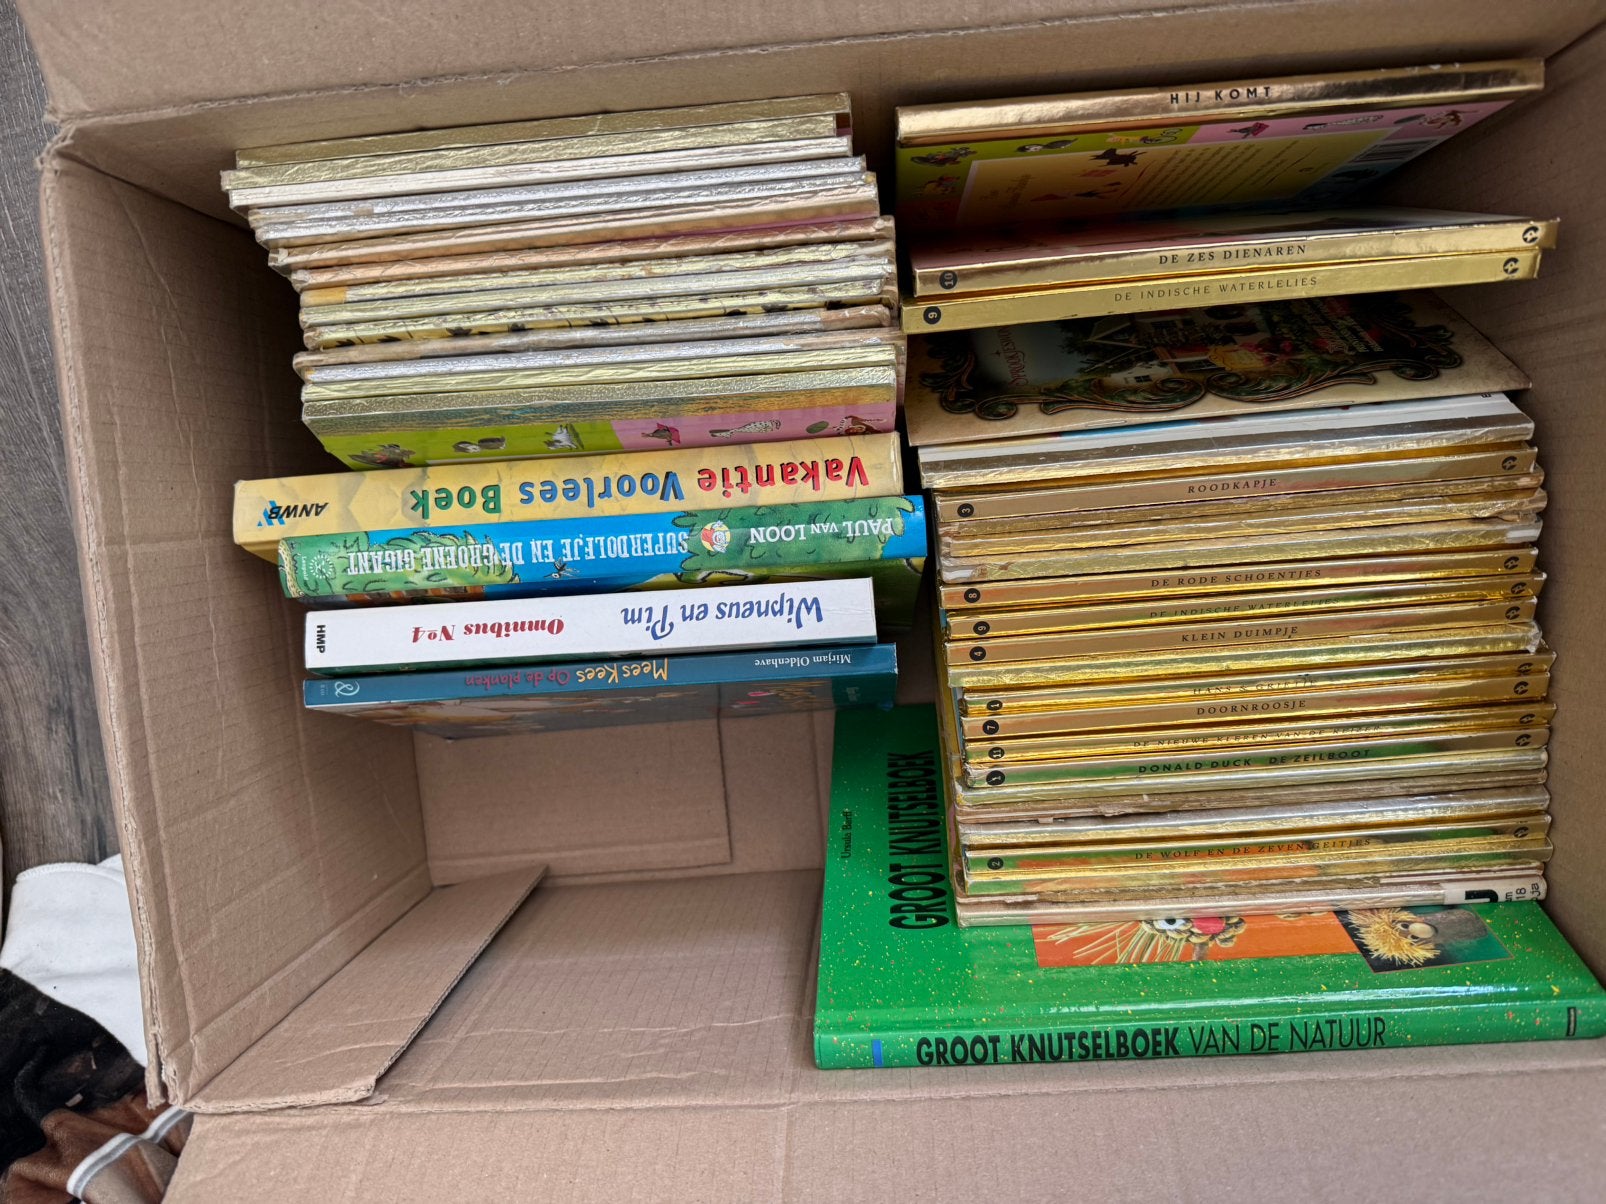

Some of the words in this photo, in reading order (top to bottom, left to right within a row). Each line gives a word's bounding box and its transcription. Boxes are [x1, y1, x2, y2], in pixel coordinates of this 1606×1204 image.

[1170, 92, 1200, 104] HIJ
[1215, 86, 1271, 101] KOMT
[1159, 254, 1179, 265] DE
[1187, 251, 1215, 263] ZES
[1223, 245, 1307, 260] DIENAREN
[943, 272, 955, 287] 10
[1114, 292, 1132, 302] DE
[1140, 285, 1211, 300] INDISCHE
[1219, 276, 1318, 293] WATERLELIES
[697, 456, 870, 498] Vakantie
[1187, 478, 1277, 494] ROODKAPJE
[518, 471, 685, 509] Voorlees
[268, 502, 329, 519] ANWB
[410, 484, 502, 519] Boek
[749, 524, 806, 544] LOON
[810, 523, 838, 534] VAN
[843, 518, 895, 538] PAUL
[420, 542, 499, 571] GROENE
[500, 541, 525, 566] DE
[530, 538, 554, 563] EN
[561, 532, 689, 561] SUPERDOLFJE
[347, 549, 416, 575] GIGANT
[1151, 578, 1170, 587] DE
[1177, 575, 1218, 586] RODE
[1225, 569, 1322, 583] SCHOENTJES
[680, 602, 708, 622] en
[715, 592, 823, 629] Wipneus
[463, 618, 565, 638] Omnibus
[620, 604, 674, 640] Pim
[316, 624, 326, 654] HMP
[1181, 631, 1226, 642] KLEIN
[1234, 626, 1298, 638] DUIMPJE
[622, 657, 669, 681] Mees
[754, 656, 809, 667] Oldenhave
[813, 654, 851, 665] Mirjam
[465, 675, 520, 690] planken
[525, 672, 542, 687] de
[543, 671, 570, 685] Op
[576, 664, 619, 684] Kees
[1197, 700, 1307, 715] DOORNROOSJE
[1138, 758, 1203, 773] DONALD
[1210, 758, 1252, 769] DUCK
[1268, 755, 1287, 765] DE
[1293, 749, 1371, 763] ZEILBOOT
[886, 751, 943, 856] KNUTSELBOEK
[841, 831, 852, 859] Ursula
[1135, 851, 1153, 860] DE
[1161, 849, 1201, 859] WOLF
[1207, 847, 1225, 856] EN
[1233, 845, 1250, 854] DE
[1257, 842, 1305, 853] ZEVEN
[1312, 838, 1371, 850] GEITJES
[888, 863, 949, 929] GROOT
[916, 1034, 1000, 1065] GROOT
[1010, 1026, 1181, 1062] KNUTSELBOEK
[1187, 1024, 1240, 1055] VAN
[1249, 1022, 1280, 1052] DE
[1289, 1016, 1386, 1051] NATUUR
